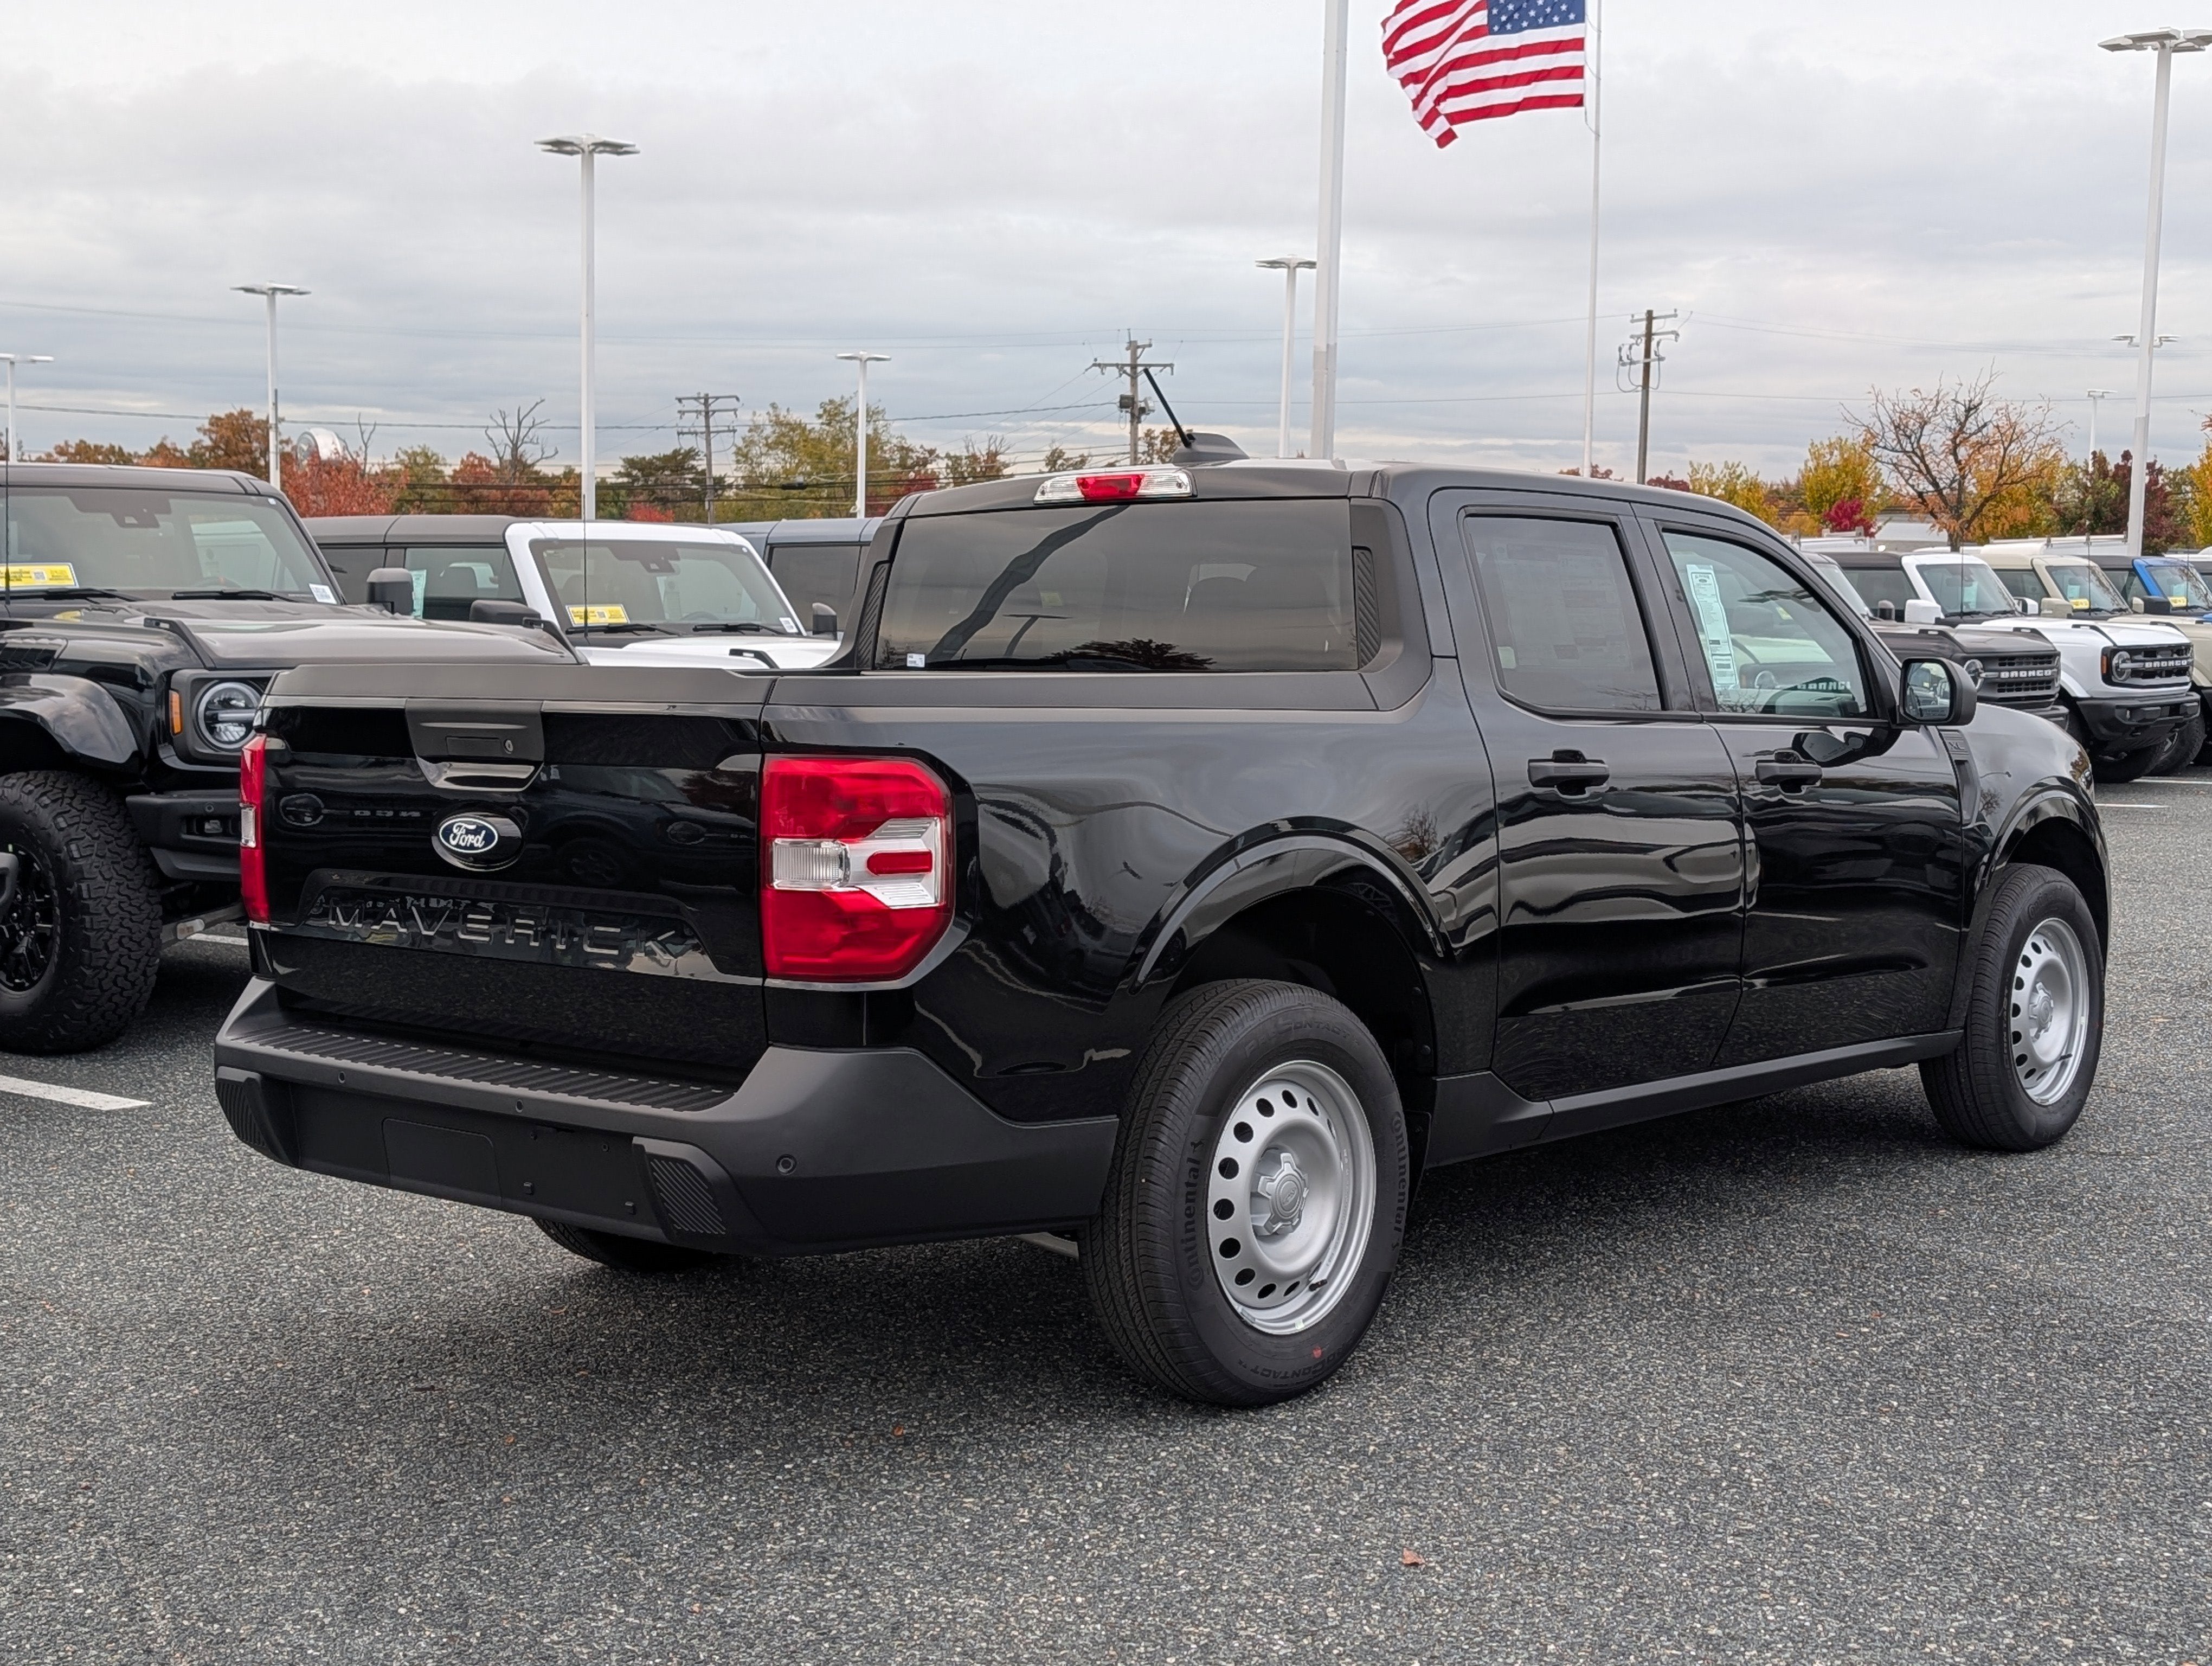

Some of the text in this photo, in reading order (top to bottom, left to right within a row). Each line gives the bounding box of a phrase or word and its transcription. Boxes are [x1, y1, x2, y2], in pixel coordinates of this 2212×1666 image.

[2145, 659, 2188, 668] BRONCO
[2000, 670, 2053, 678] BRONCO
[1949, 742, 1965, 751] XL
[449, 822, 486, 848] Ford
[327, 898, 680, 959] MAVERICK
